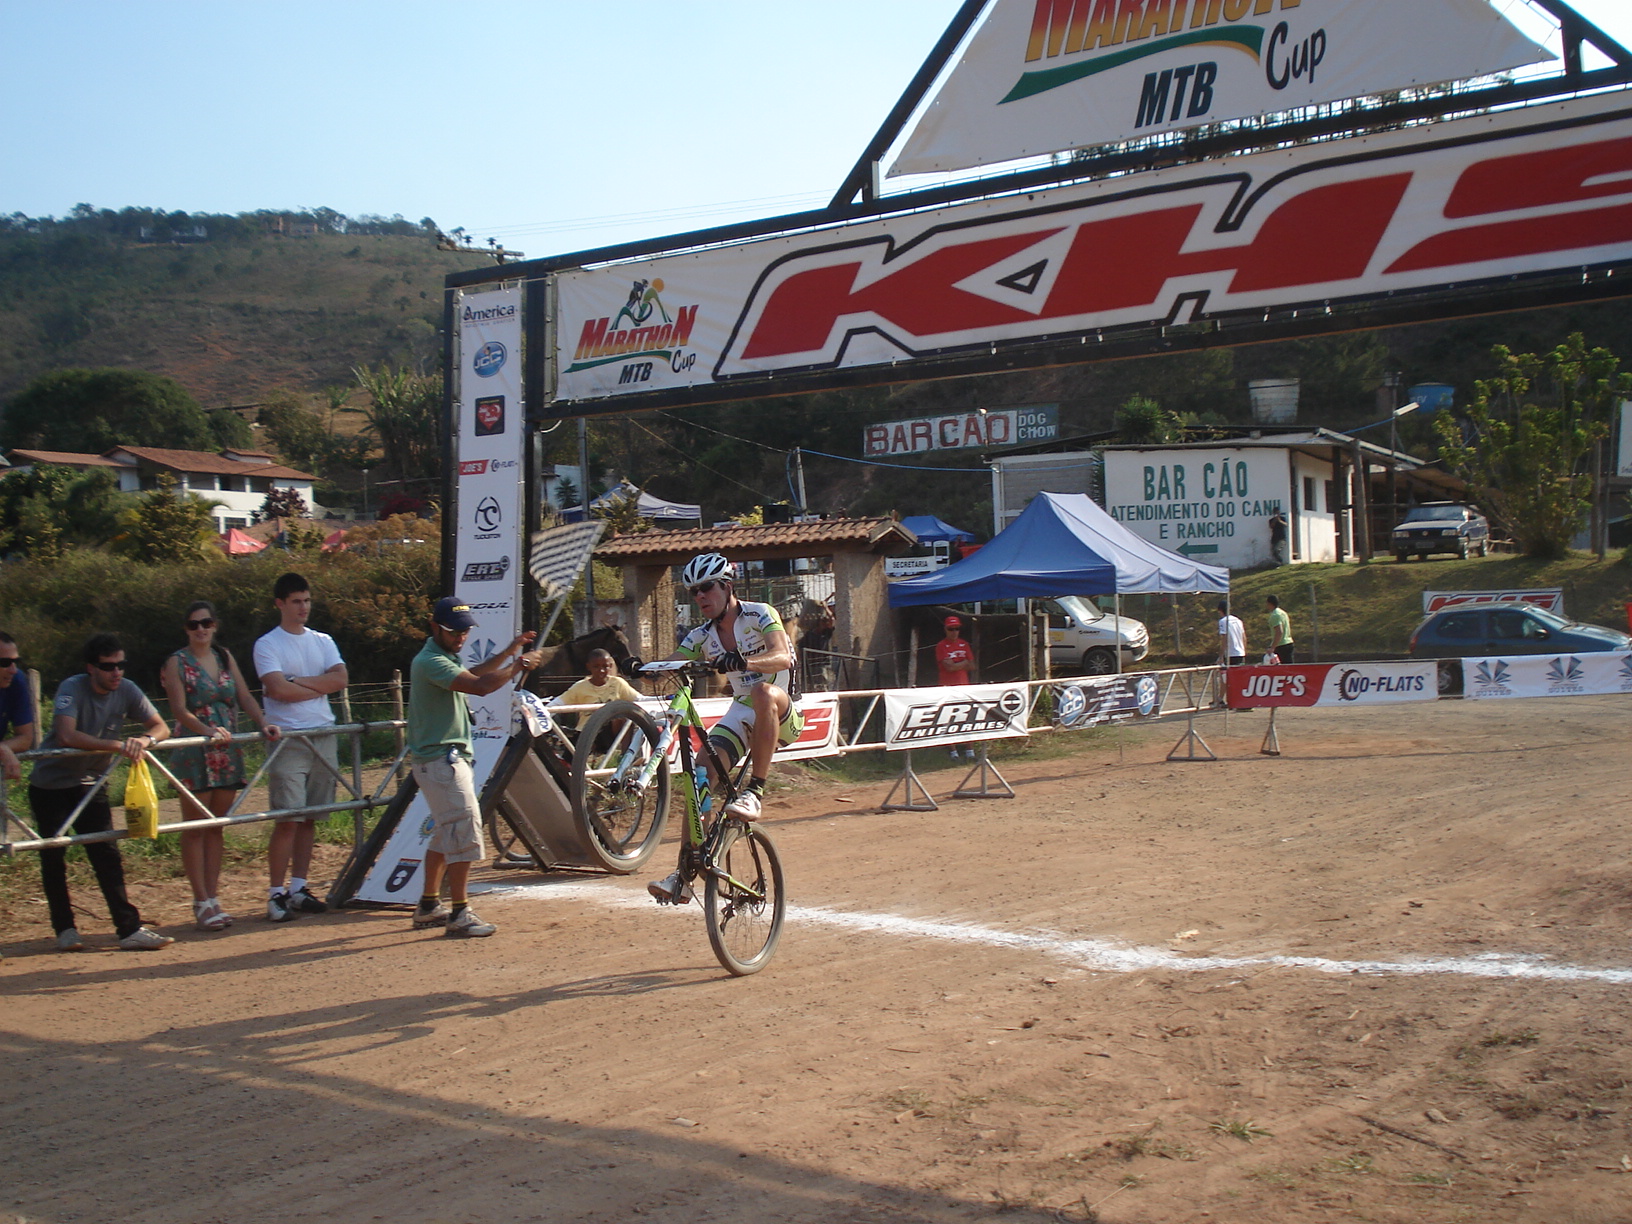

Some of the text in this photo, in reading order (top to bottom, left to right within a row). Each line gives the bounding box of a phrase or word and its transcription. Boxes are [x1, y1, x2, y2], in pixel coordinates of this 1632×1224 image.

[1266, 21, 1326, 90] Cup
[1134, 61, 1218, 128] MTB
[463, 305, 515, 320] America
[574, 304, 699, 360] MARATHON
[671, 350, 696, 373] Cup
[618, 362, 653, 384] MTB
[1018, 413, 1047, 427] DOG
[867, 414, 1009, 454] BAR CÃO
[1018, 425, 1057, 439] CHOW
[1144, 457, 1248, 501] BAR CÃO
[1110, 501, 1210, 522] ATENDIMENTO
[1216, 501, 1235, 518] DO
[1160, 521, 1235, 539] E RANCHO
[1242, 675, 1424, 697] JOE'S NO-FLATS
[905, 702, 1000, 729] ERT
[899, 720, 1007, 739] UNIFORMES
